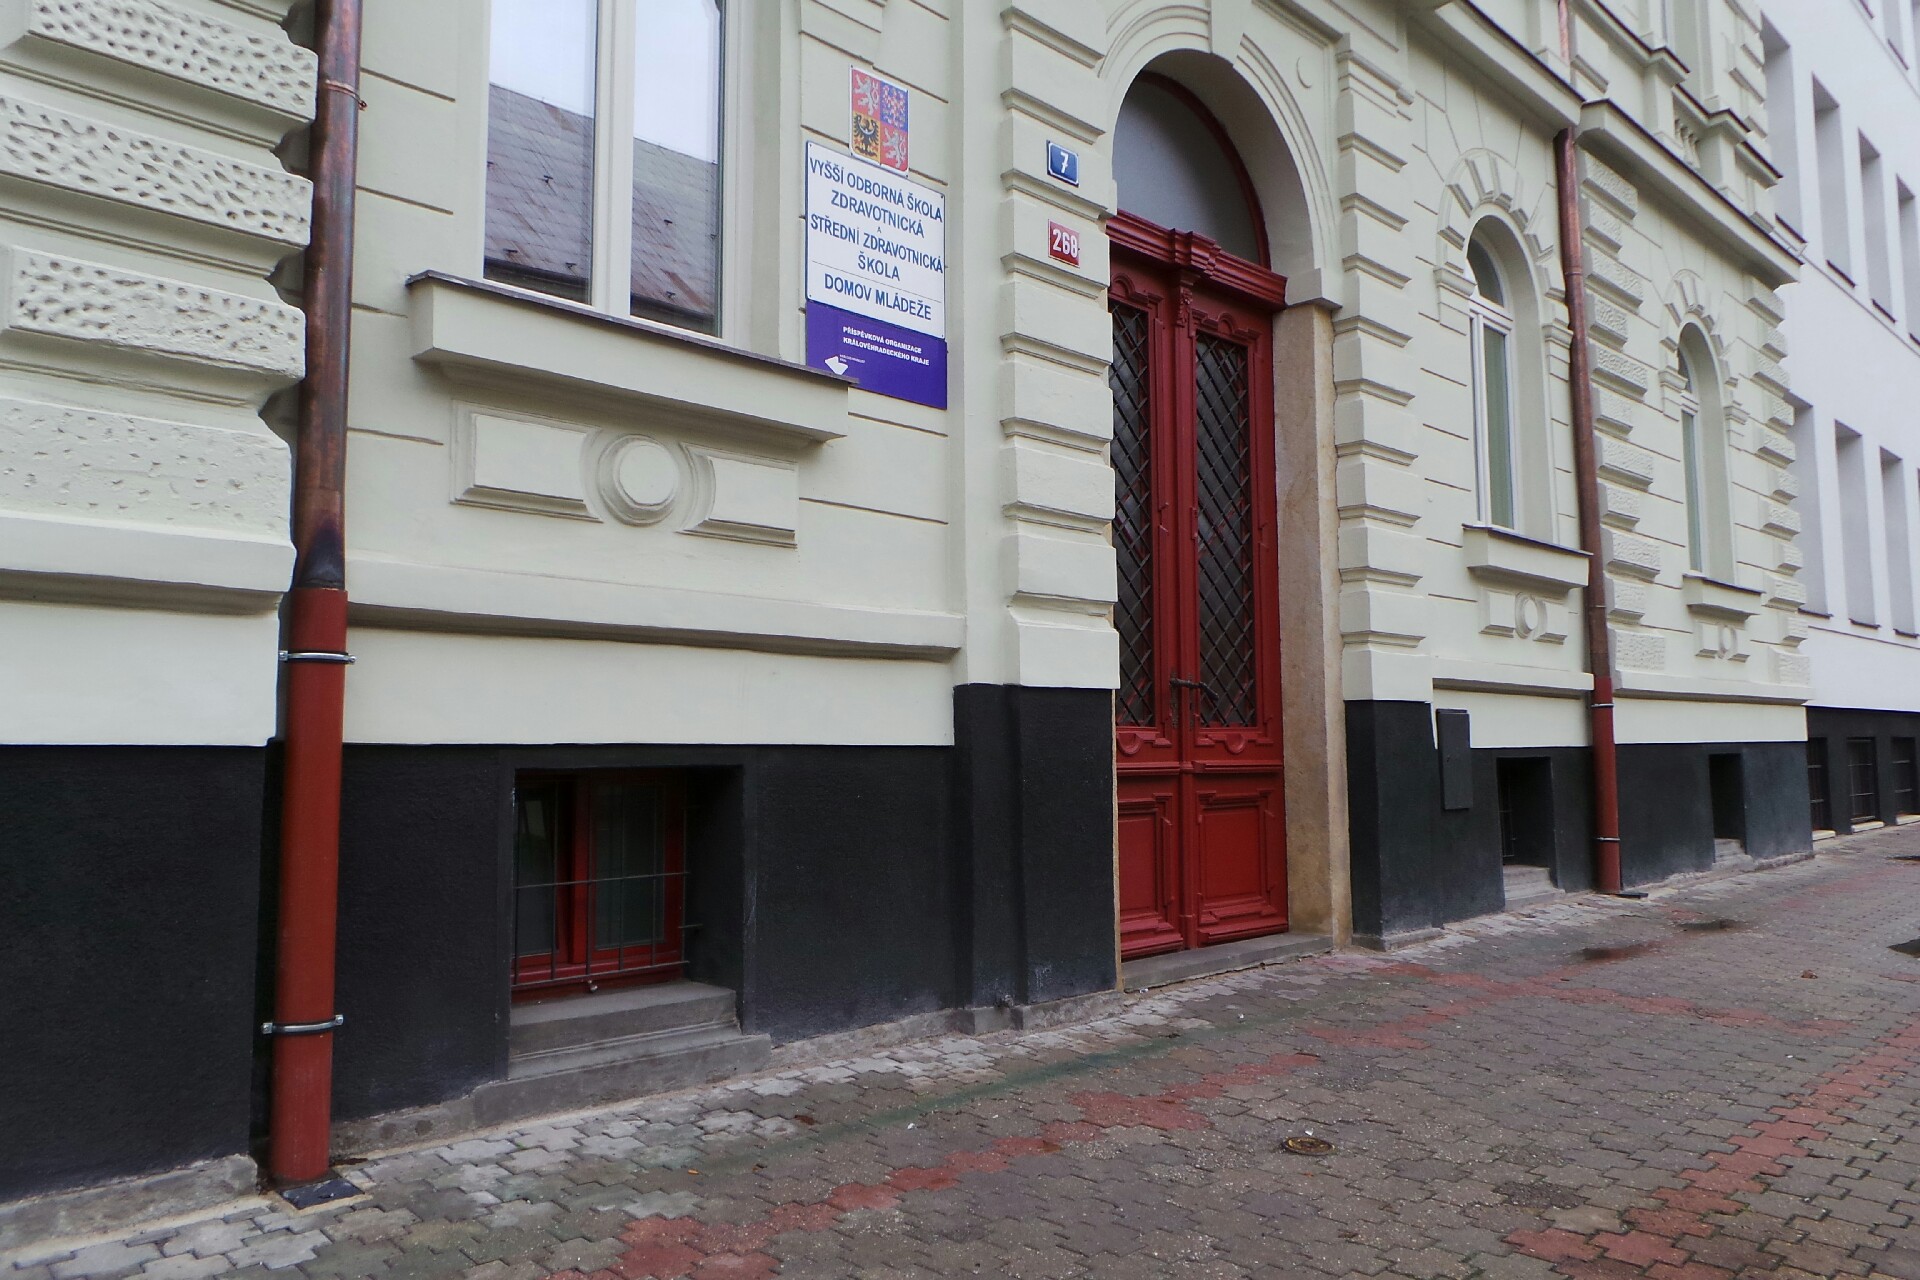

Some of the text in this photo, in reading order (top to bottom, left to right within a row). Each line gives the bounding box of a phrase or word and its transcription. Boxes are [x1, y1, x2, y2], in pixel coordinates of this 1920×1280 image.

[1060, 151, 1068, 174] 7
[810, 157, 943, 223] VYŠŠÍ ODBORNÁ ŠKOLA
[831, 190, 925, 238] ZDRAVOTNICKÁ
[810, 213, 943, 274] STŘEDNÍ ZDRAVOTNICKÁ
[877, 226, 882, 234] A
[1052, 228, 1078, 258] 268
[858, 251, 900, 281] ŠKOLA
[824, 273, 932, 321] DOMOV MLÁDEŽE
[842, 326, 922, 354] PŘÍSPĚVKOVÁ ORGANIZACE
[843, 337, 910, 361] KRÁLOVÉHRADECKÉHO
[911, 355, 930, 366] KRAJE
